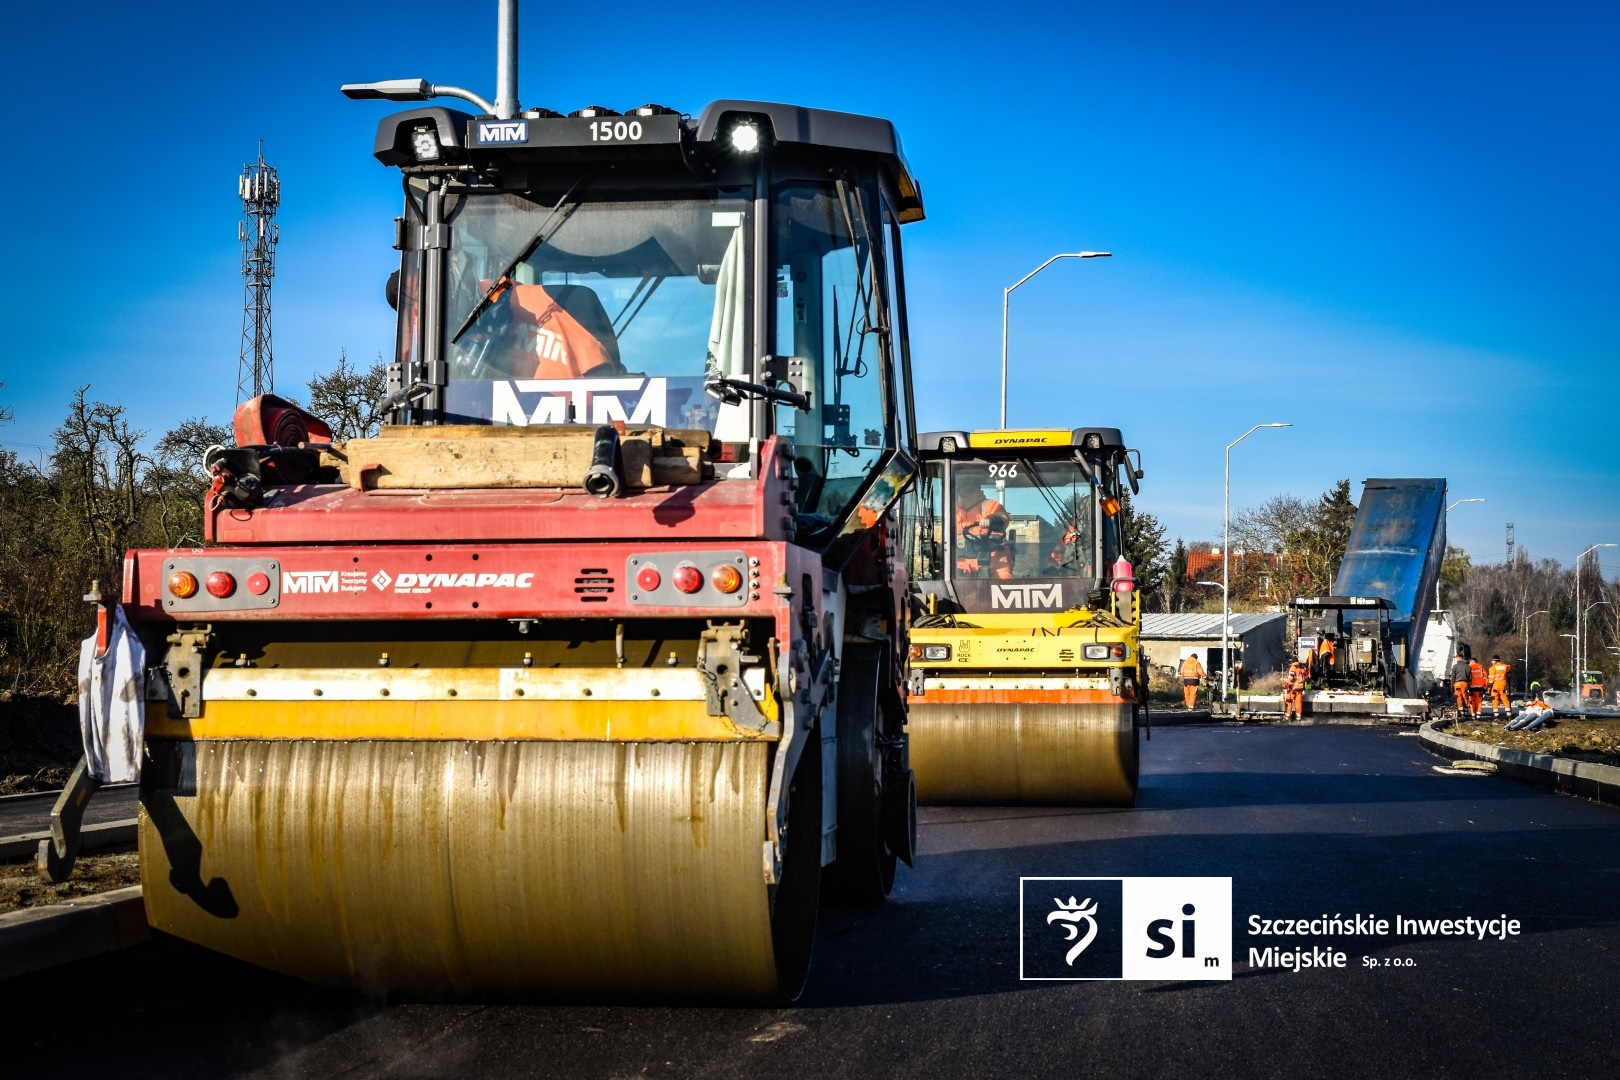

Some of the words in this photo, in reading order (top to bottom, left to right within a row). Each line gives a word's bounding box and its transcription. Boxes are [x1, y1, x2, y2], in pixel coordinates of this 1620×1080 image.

[480, 122, 526, 142] MTM
[590, 121, 643, 141] 1500
[492, 377, 667, 427] MTM
[994, 437, 1048, 445] DYNAPAC
[988, 464, 1018, 478] 966
[282, 570, 339, 594] MTM
[394, 572, 535, 588] DYNAPAC
[991, 583, 1063, 609] MTM
